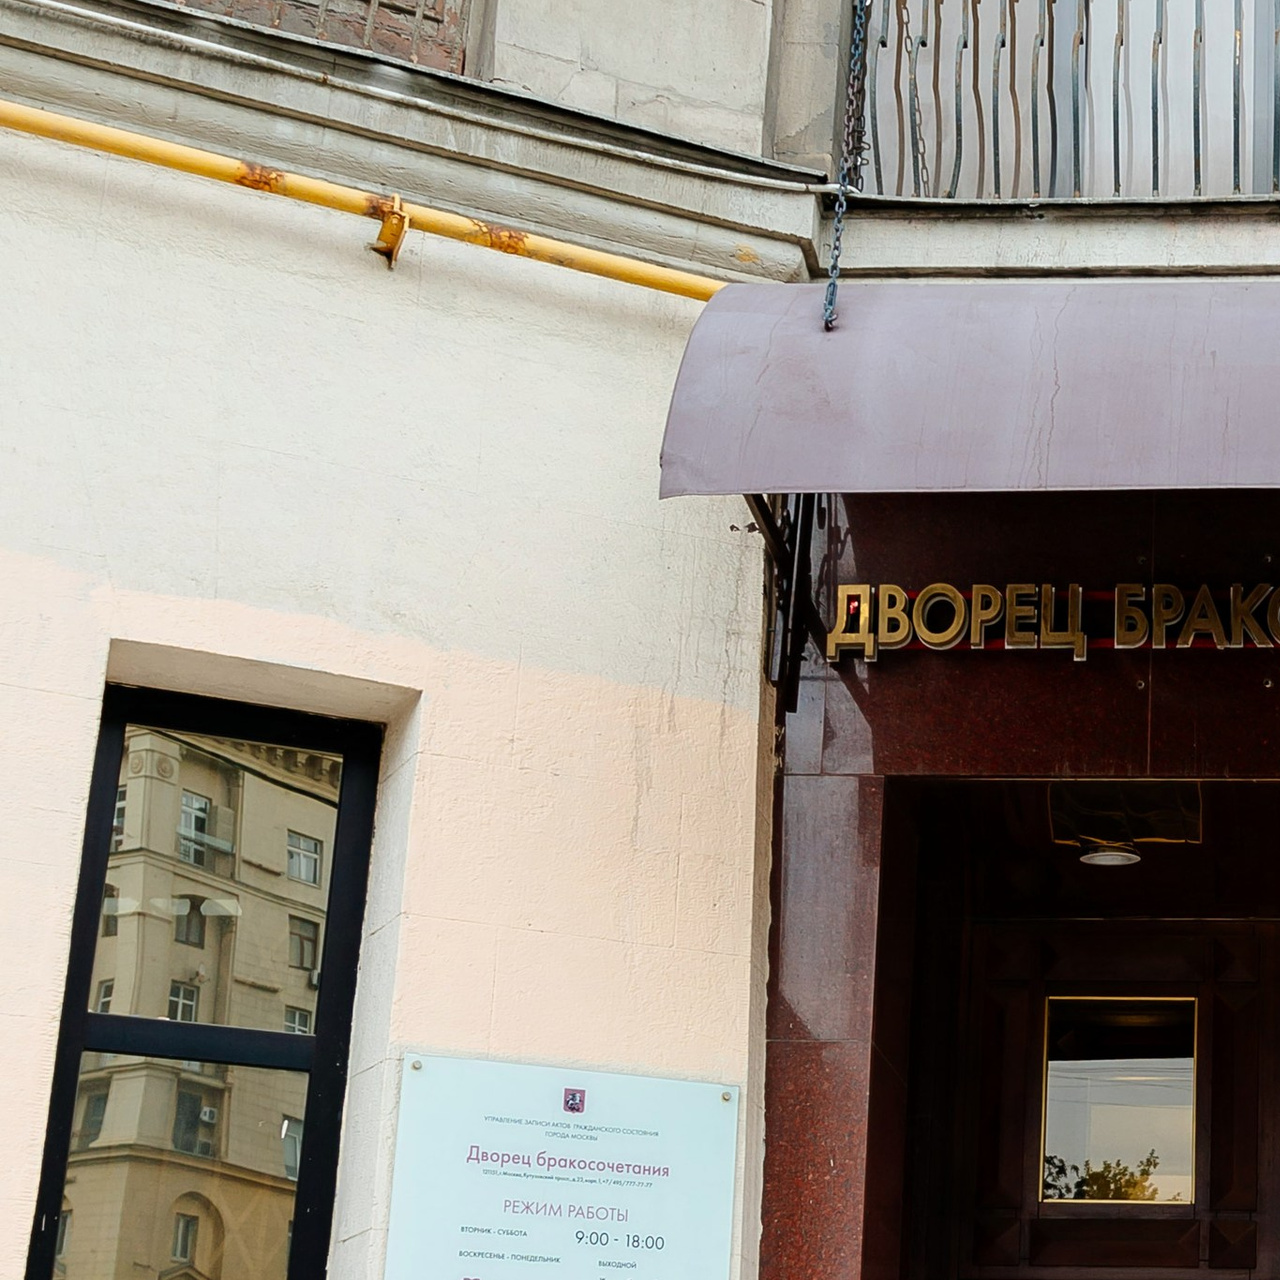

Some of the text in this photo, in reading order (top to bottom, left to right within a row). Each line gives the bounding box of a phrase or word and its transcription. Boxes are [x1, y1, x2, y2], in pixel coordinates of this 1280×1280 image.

[826, 582, 1086, 662] ДВОРЕЦ
[484, 1115, 659, 1137] УПРАВЛЕНИЕ ЗАПИСИ АКТОВ ГРАЖДАНСКОГО СОСТОЯНИЯ
[545, 1131, 598, 1141] ГОРОДА МОСКВЫ
[466, 1145, 670, 1177] Дворец бракосочетания
[503, 1199, 629, 1222] РЕЖИМ РАБОТЫ
[460, 1226, 492, 1235] ВТОРНИК
[497, 1228, 527, 1237] СУББОТА
[575, 1230, 609, 1246] 9:00
[625, 1233, 665, 1250] 18:00
[459, 1250, 505, 1260] ВОСКРЕСЕНЬЕ
[511, 1254, 561, 1263] ПОНЕДЕЛЬНИК
[598, 1260, 637, 1269] ВЫХОДНОЙ
